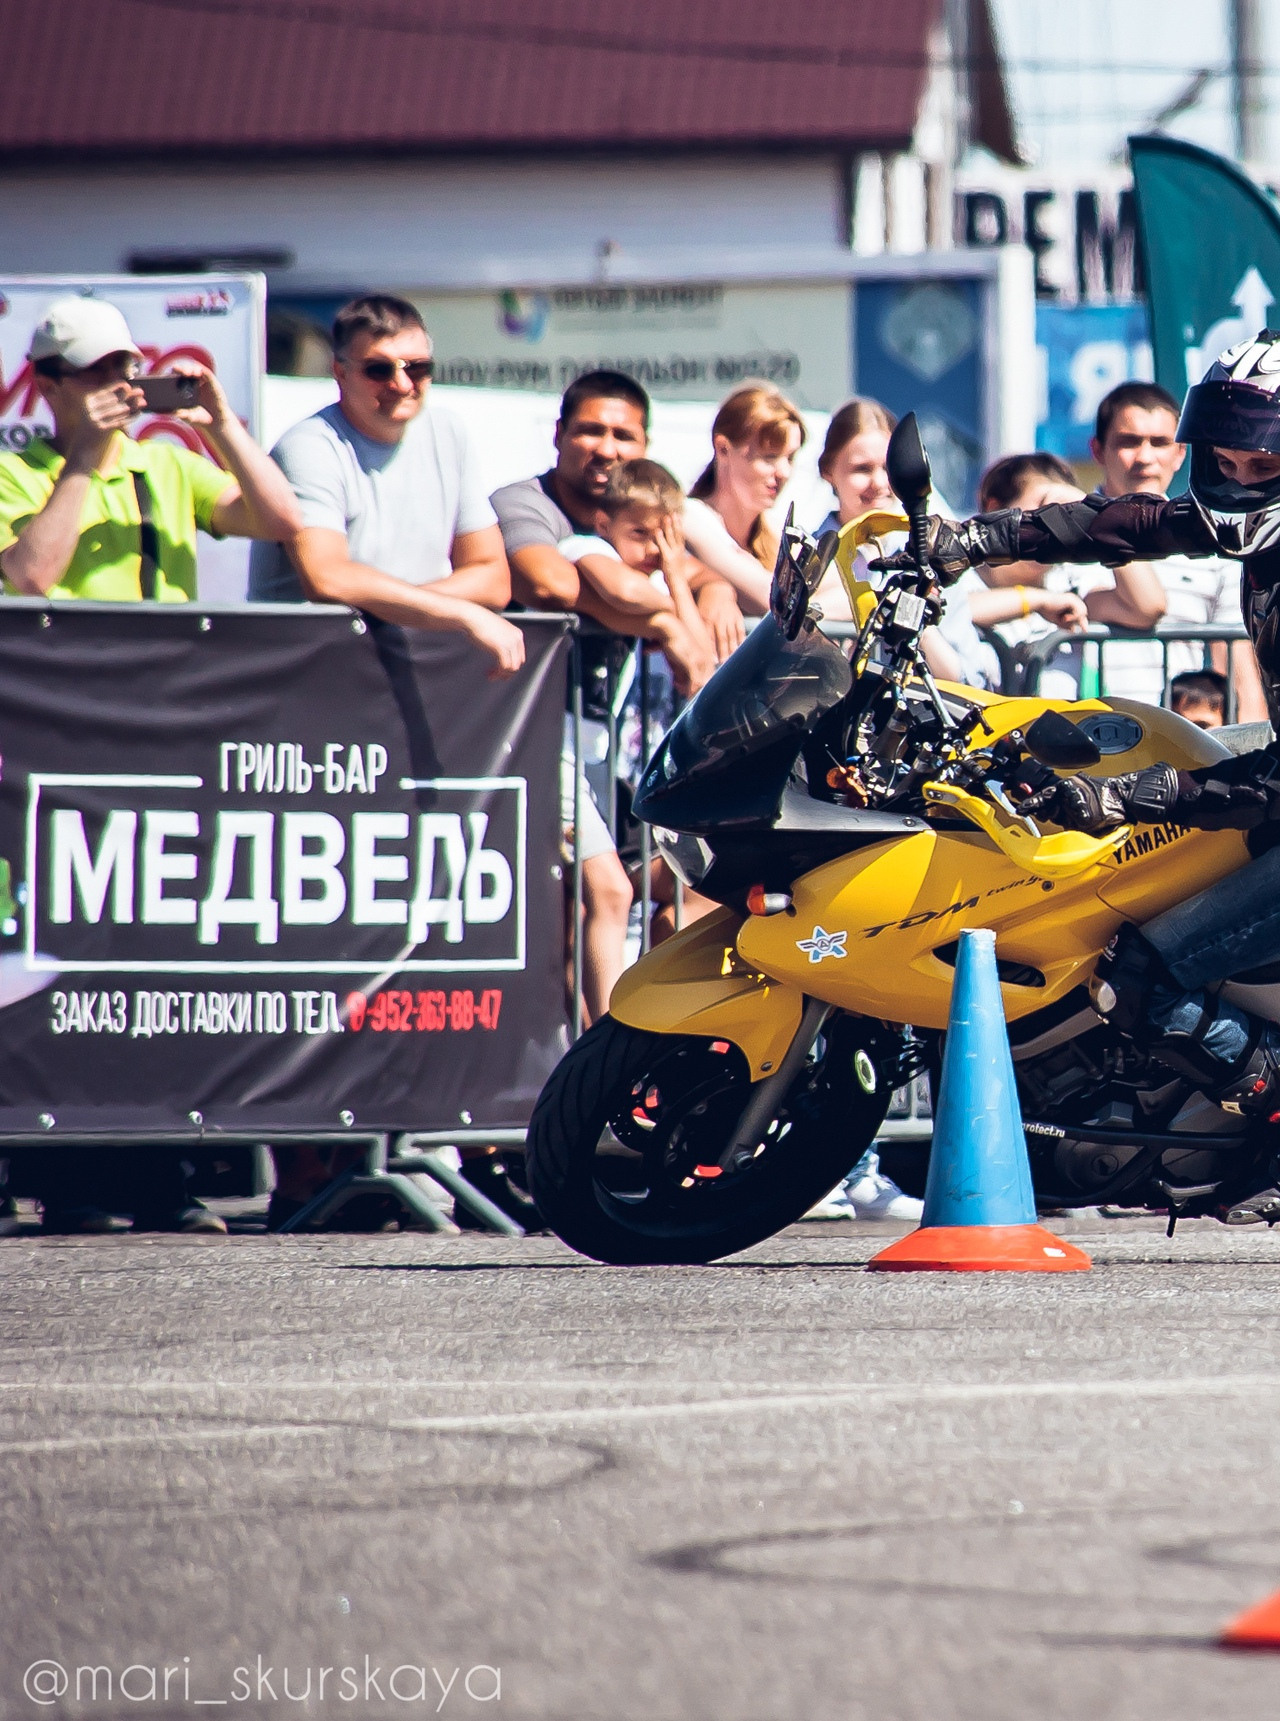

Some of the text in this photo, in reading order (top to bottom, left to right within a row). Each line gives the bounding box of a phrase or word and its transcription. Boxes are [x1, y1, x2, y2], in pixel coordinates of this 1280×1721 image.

[219, 742, 389, 795] ГРИЛЬ-БАР
[49, 808, 513, 944] МЕДВЕДЬ
[859, 895, 981, 939] TDM
[51, 990, 127, 1034] ЗАКАЗ
[132, 990, 251, 1038] ДОСТАВКИ
[257, 990, 288, 1034] ПО
